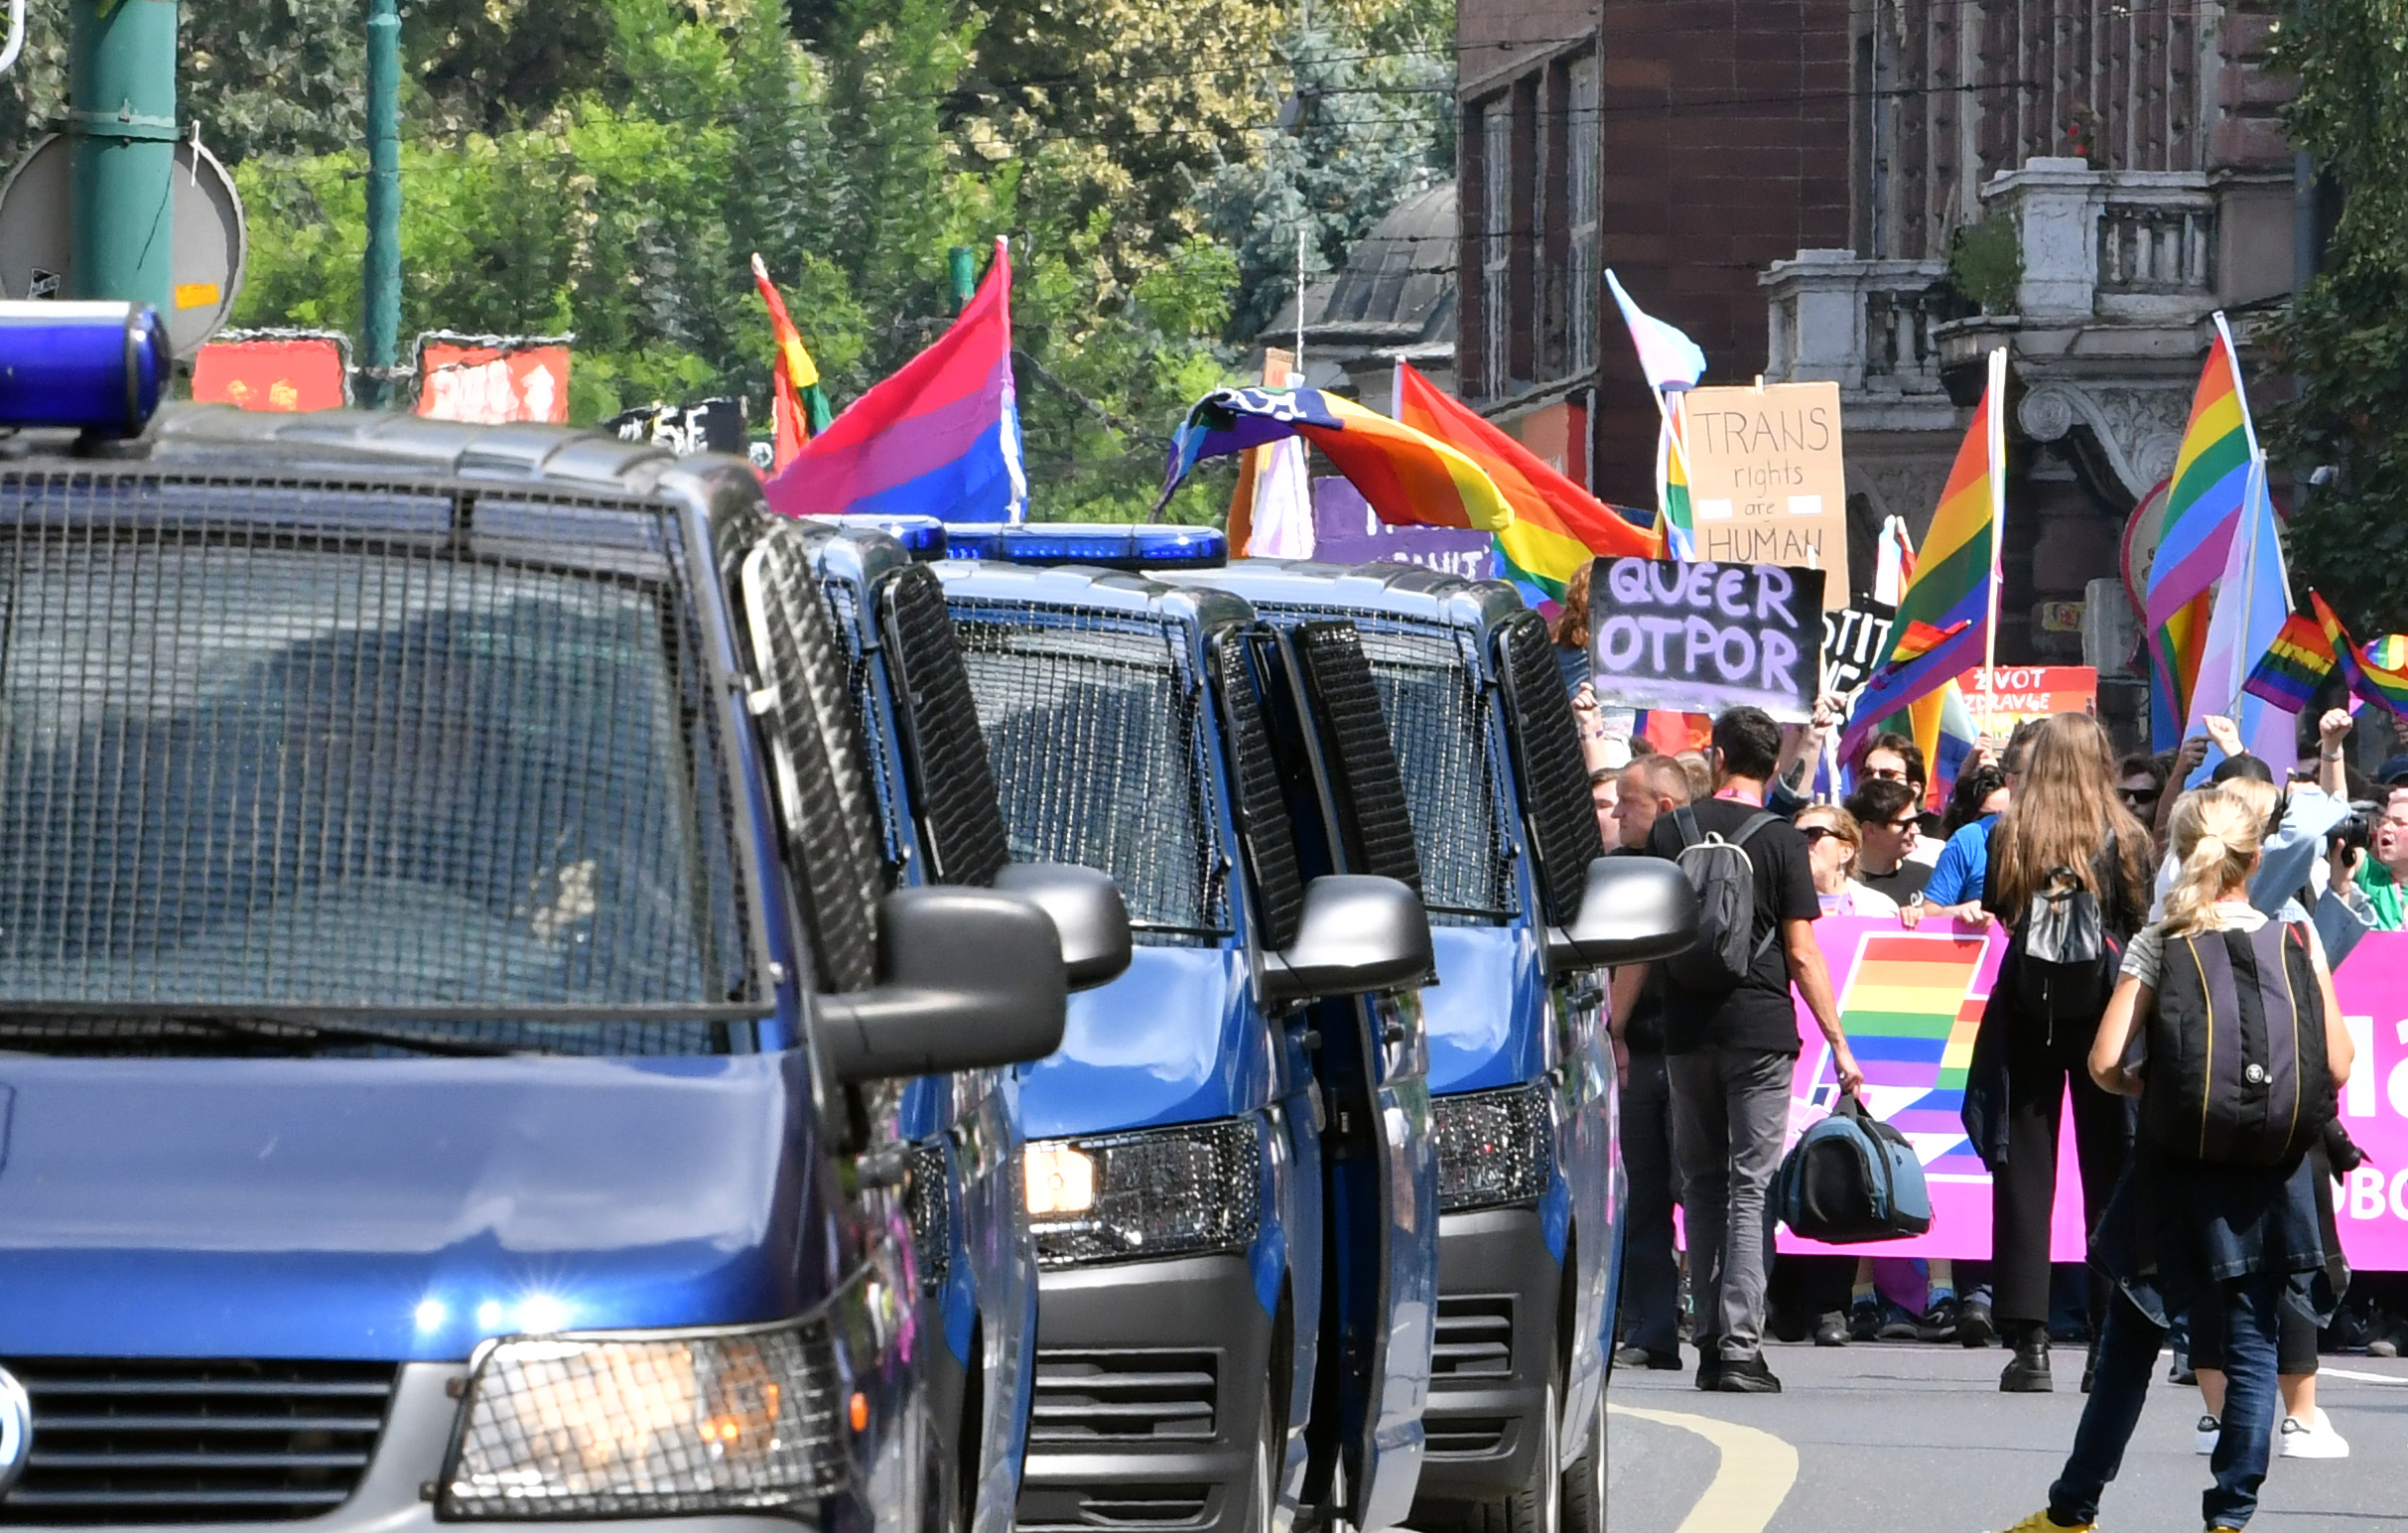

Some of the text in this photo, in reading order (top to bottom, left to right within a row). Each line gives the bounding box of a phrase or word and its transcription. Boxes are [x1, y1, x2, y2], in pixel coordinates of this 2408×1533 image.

[1692, 407, 1829, 454] TRANS
[1734, 460, 1804, 498] rights
[1744, 502, 1776, 515] are
[1708, 528, 1822, 562] HUMAN
[1609, 556, 1799, 628] QUEER
[1597, 615, 1799, 694] OTPOR
